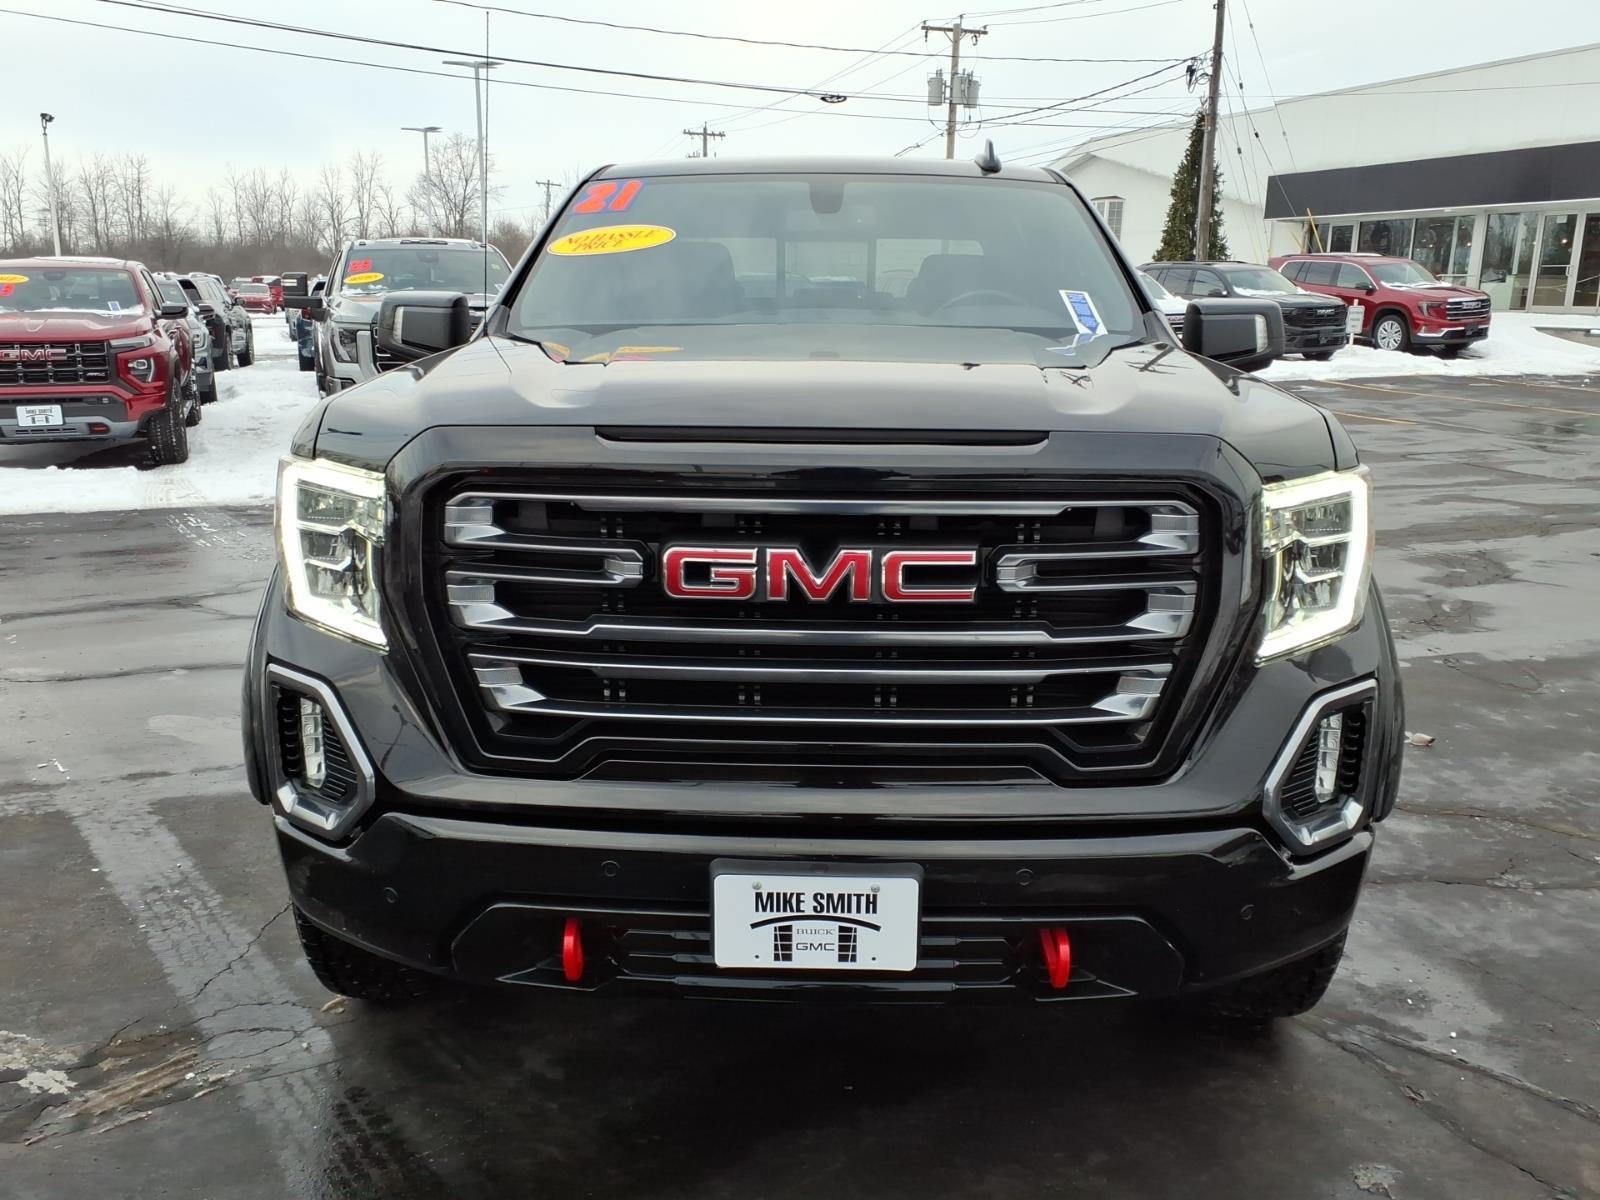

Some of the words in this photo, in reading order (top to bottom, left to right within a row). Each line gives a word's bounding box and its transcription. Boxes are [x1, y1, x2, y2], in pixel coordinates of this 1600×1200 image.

[572, 179, 643, 214] 21
[0, 348, 68, 361] GMC
[663, 546, 977, 602] GMC
[754, 891, 806, 914] MIKE
[812, 892, 878, 915] SMITH
[796, 928, 835, 936] BUICK
[796, 942, 836, 952] GMC
